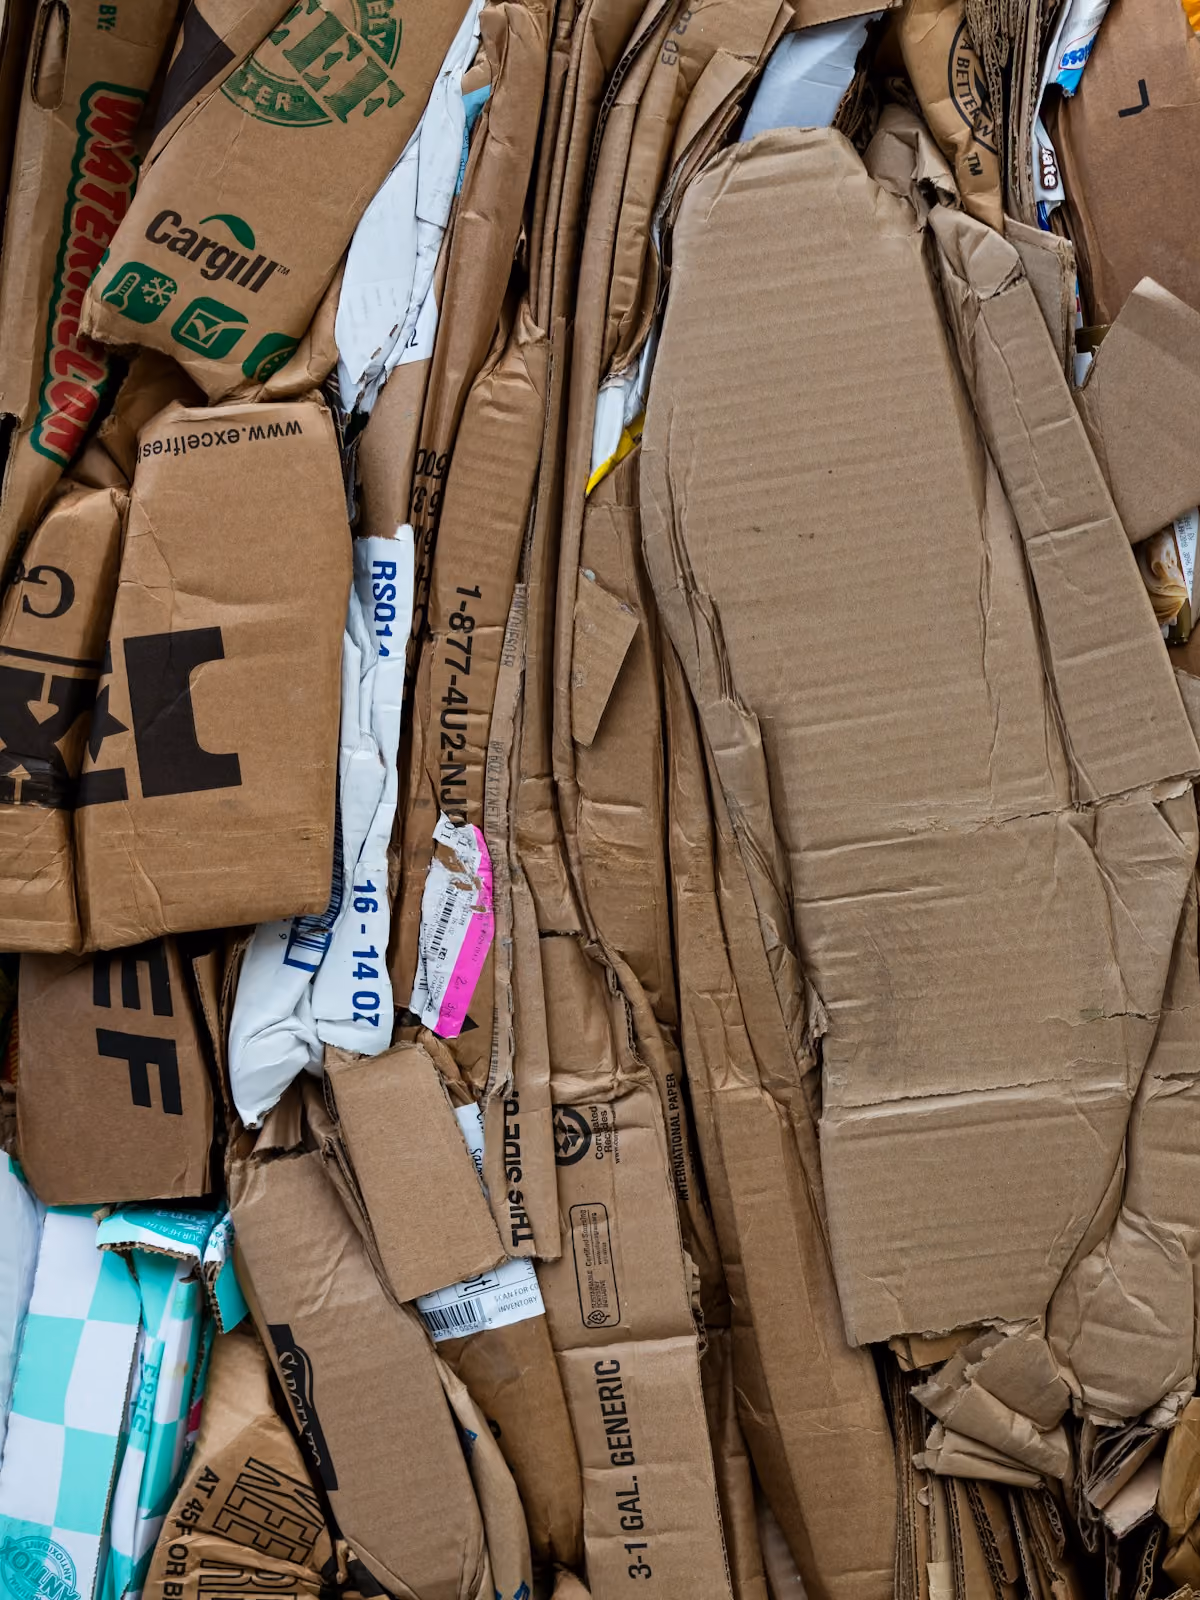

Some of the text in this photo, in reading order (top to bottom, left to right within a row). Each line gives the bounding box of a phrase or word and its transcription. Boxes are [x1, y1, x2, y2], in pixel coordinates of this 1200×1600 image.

[956, 57, 983, 120] BETTER
[145, 209, 276, 293] Cargill
[352, 879, 378, 914] 16
[351, 945, 380, 980] 14
[666, 1073, 677, 1107] PAPER
[589, 1105, 604, 1160] Corrugated
[669, 1110, 690, 1201] INTERNATIONAL
[498, 1295, 539, 1314] INVENTORY
[593, 1359, 652, 1581] 3-1 GAL. GENERIC
